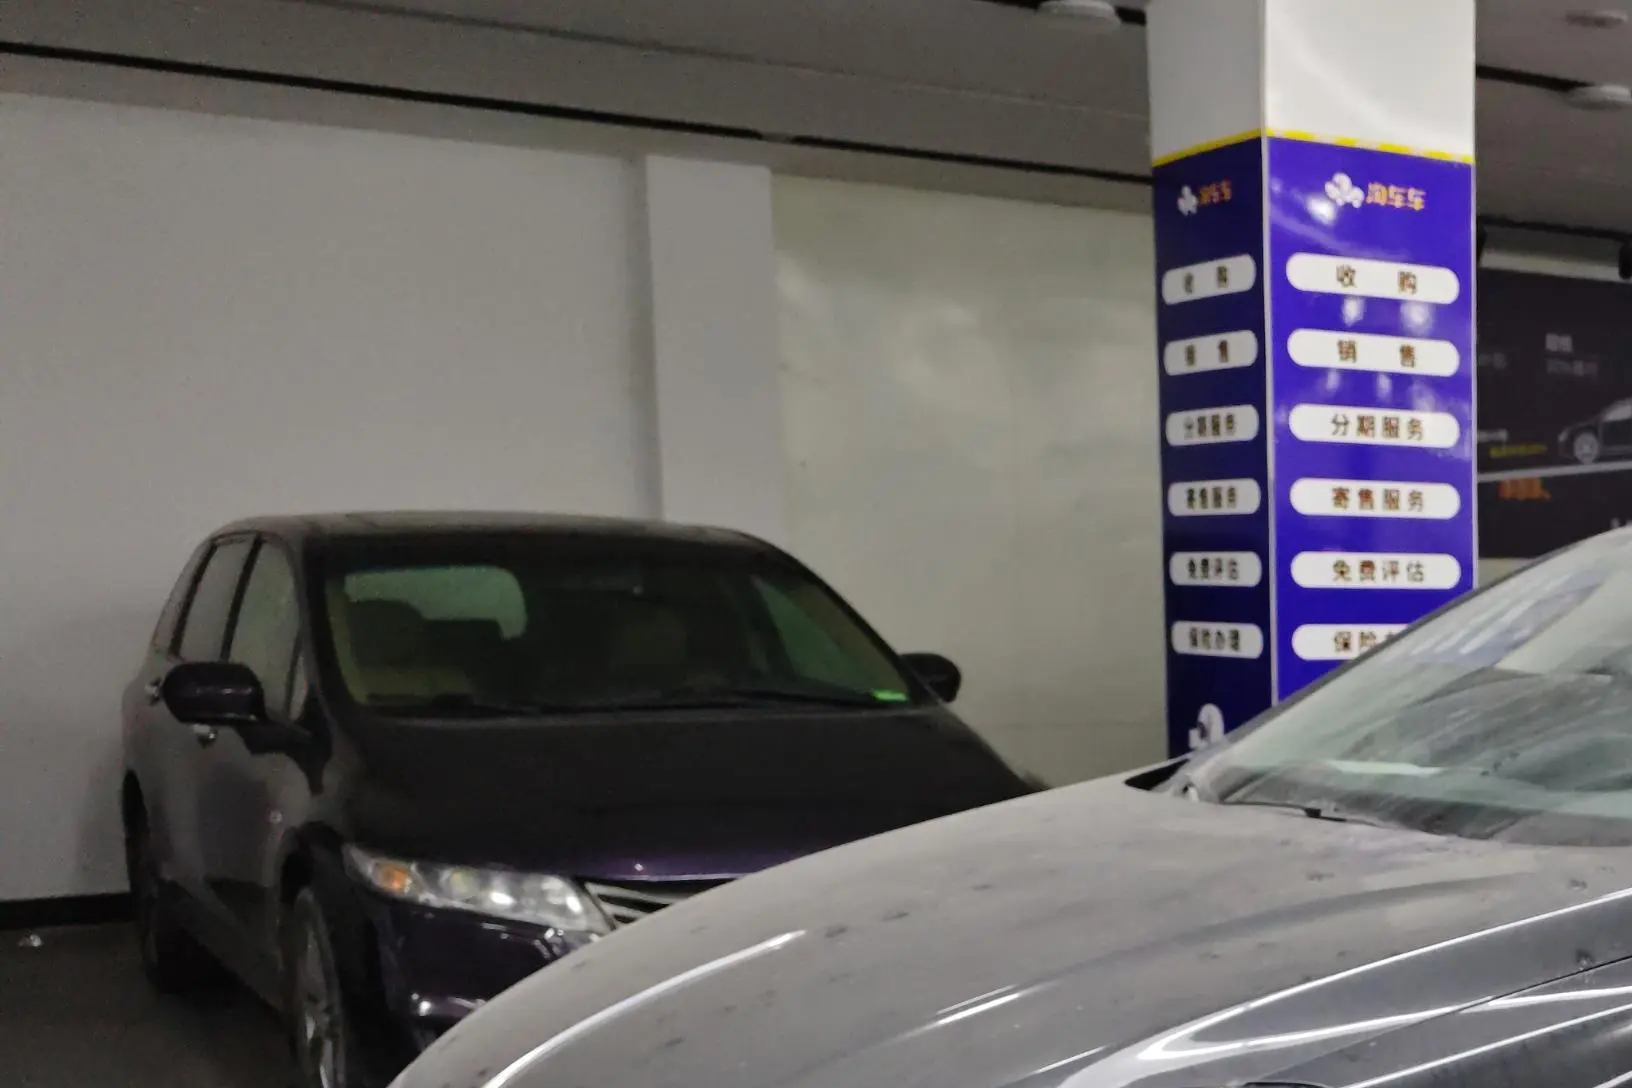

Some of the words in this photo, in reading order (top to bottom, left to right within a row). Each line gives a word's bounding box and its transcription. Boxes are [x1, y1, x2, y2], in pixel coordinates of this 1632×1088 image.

[1332, 413, 1424, 441] 分期服务
[1332, 487, 1424, 512] 寄售服务
[1332, 559, 1425, 582] 免费评估
[1333, 631, 1394, 651] 保险
